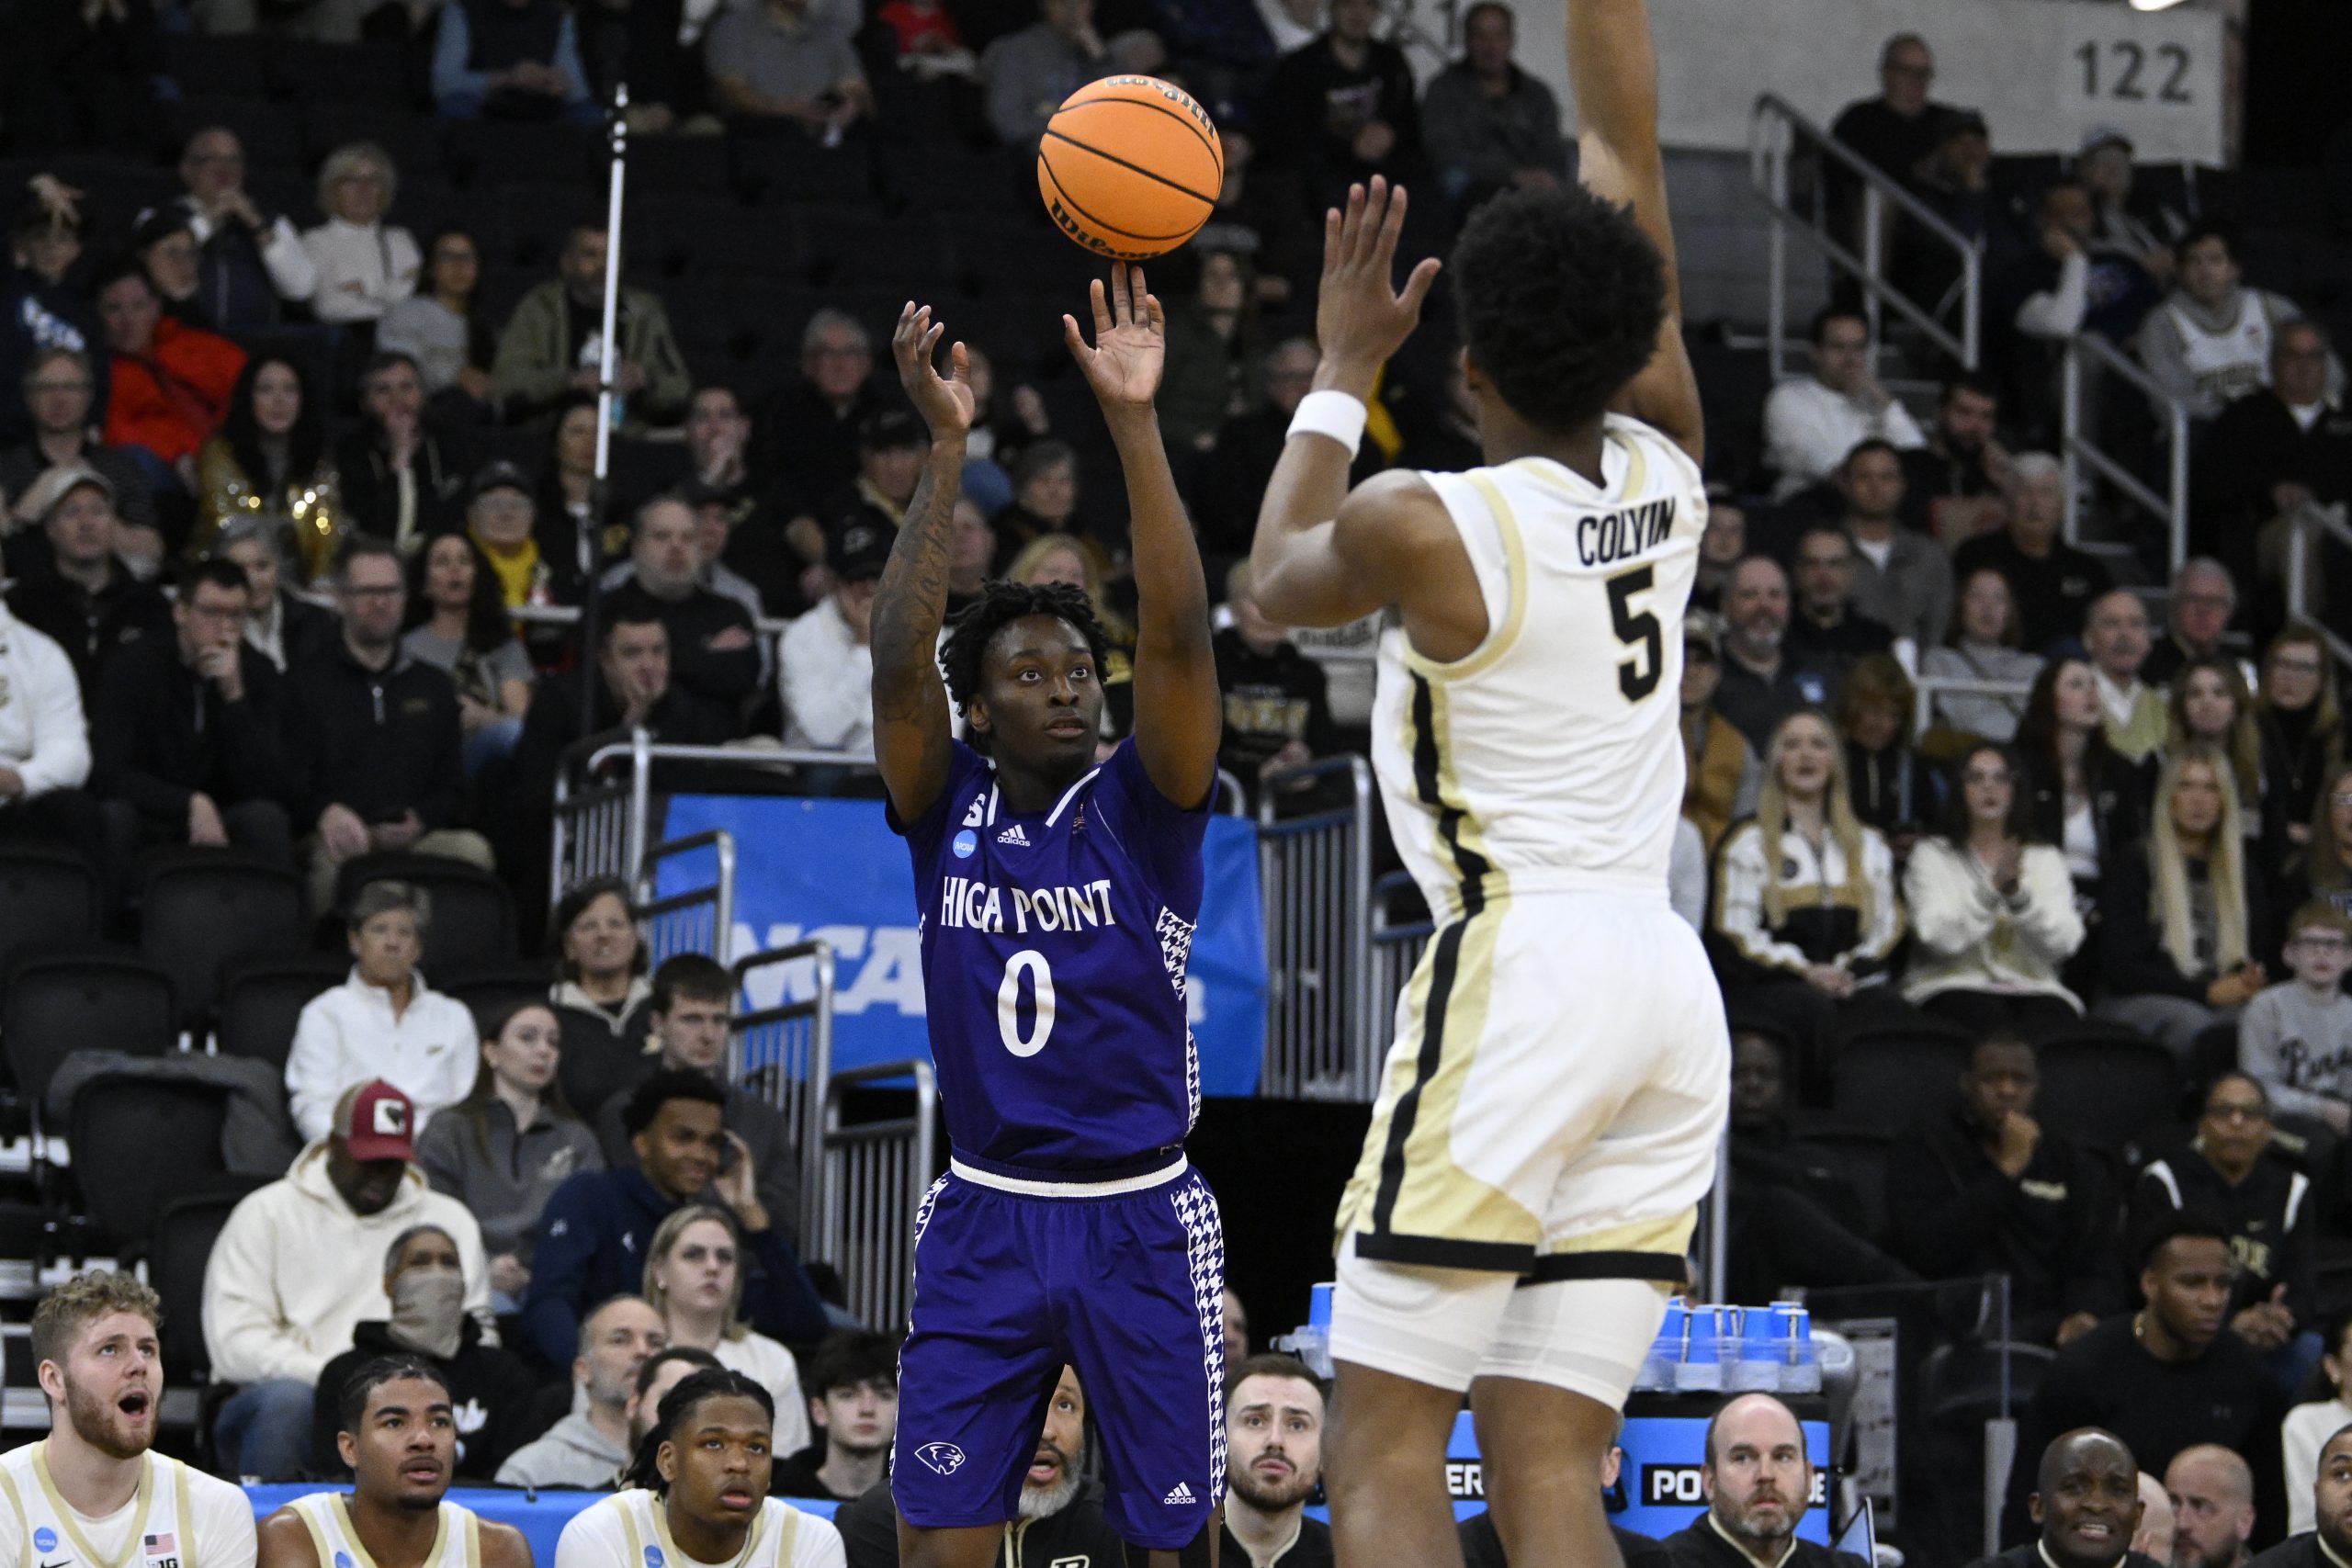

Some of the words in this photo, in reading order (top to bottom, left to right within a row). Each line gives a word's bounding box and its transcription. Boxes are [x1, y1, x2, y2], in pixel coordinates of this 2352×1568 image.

[2075, 40, 2190, 102] 122
[1051, 197, 1161, 257] Wilson
[1605, 562, 1663, 705] 5
[998, 835, 1031, 847] adidas
[1011, 879, 1116, 934] POINT
[730, 922, 927, 1016] NCA
[998, 949, 1056, 1057] 0
[1164, 1495, 1196, 1505] adidas
